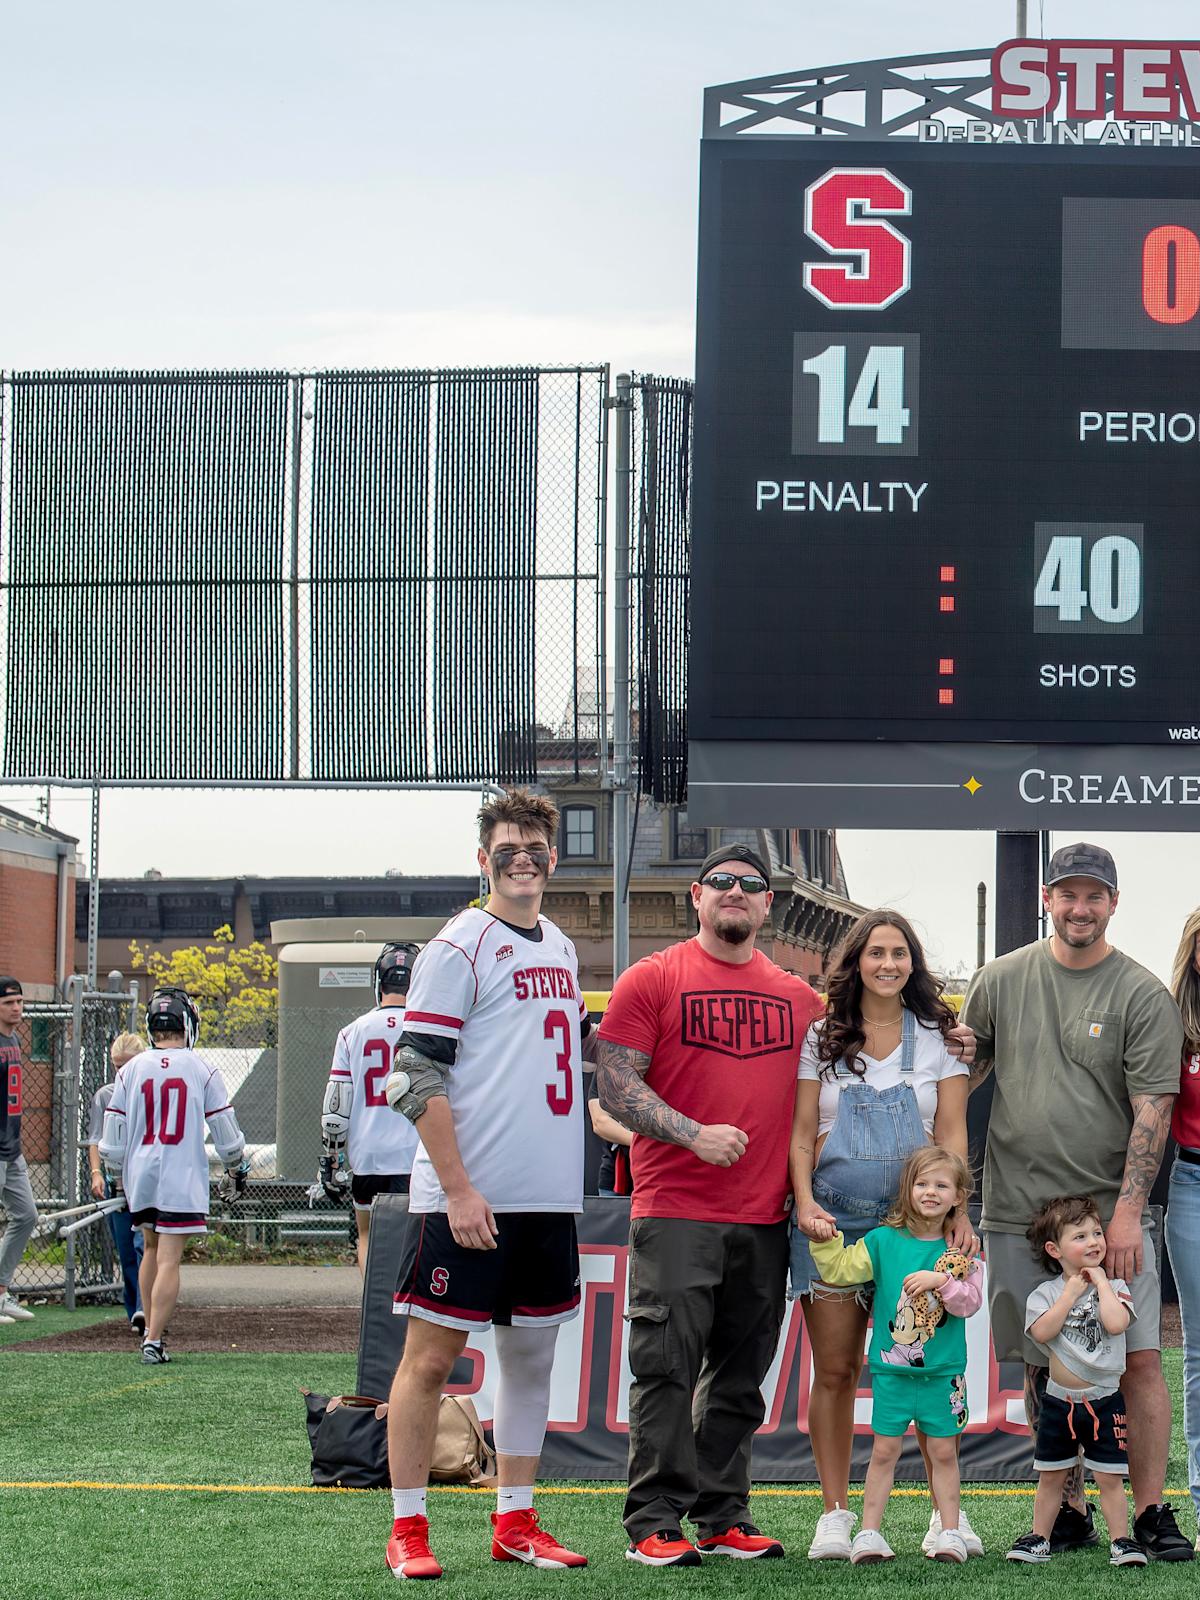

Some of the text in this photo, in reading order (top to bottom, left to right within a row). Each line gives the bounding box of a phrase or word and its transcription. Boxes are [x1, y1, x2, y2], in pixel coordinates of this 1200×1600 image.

[803, 167, 912, 310] S
[803, 344, 910, 444] 14
[756, 481, 928, 512] PENALTY
[1034, 535, 1142, 623] 40
[1039, 664, 1137, 688] SHOTS
[386, 1016, 397, 1029] S
[690, 997, 786, 1050] RESPECT
[160, 1057, 170, 1069] S
[543, 1009, 574, 1117] 3
[141, 1077, 188, 1146] 10
[430, 1267, 449, 1296] S
